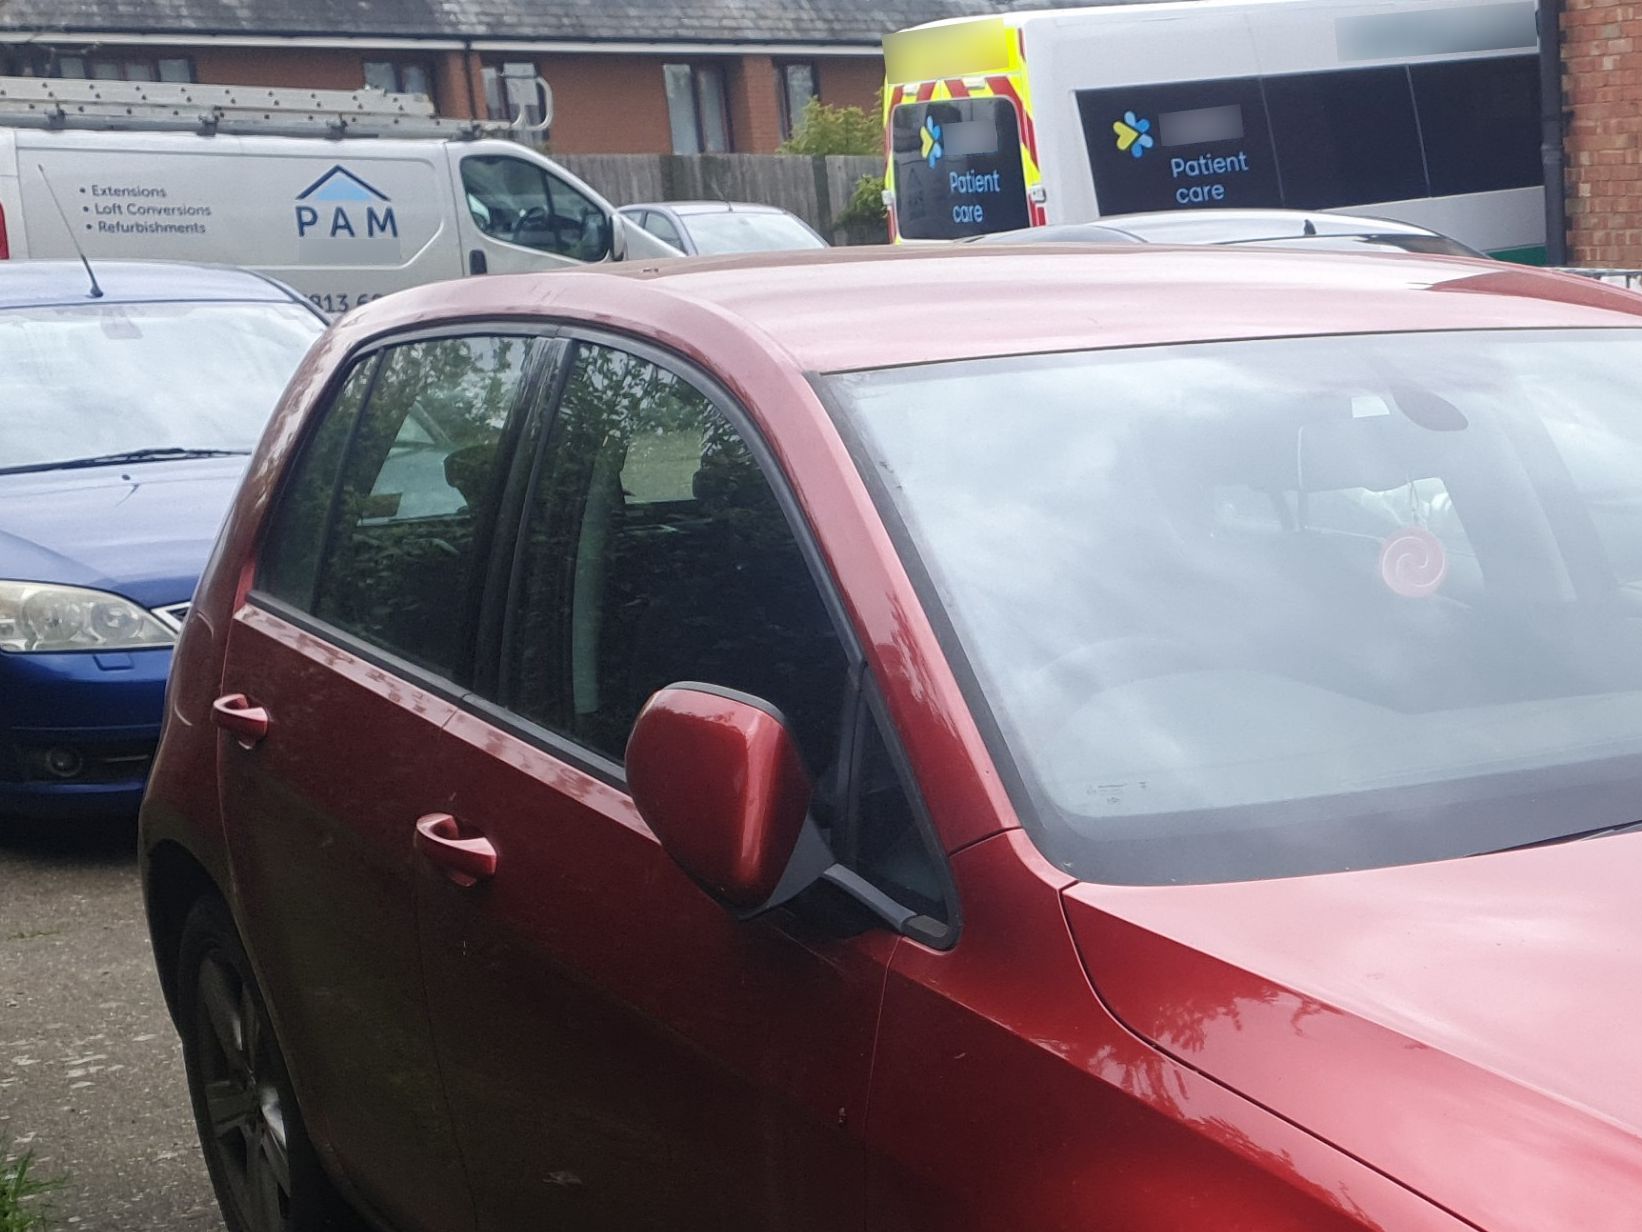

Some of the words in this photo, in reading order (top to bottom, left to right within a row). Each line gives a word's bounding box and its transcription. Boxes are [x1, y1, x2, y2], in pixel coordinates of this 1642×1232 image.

[1171, 151, 1248, 178] Patient
[91, 184, 167, 198] Extensions
[949, 169, 1000, 194] Patient
[1176, 183, 1225, 204] care
[94, 203, 123, 216] Loft
[126, 203, 212, 216] Conversions
[952, 204, 983, 223] care
[98, 220, 206, 233] Refurbishments
